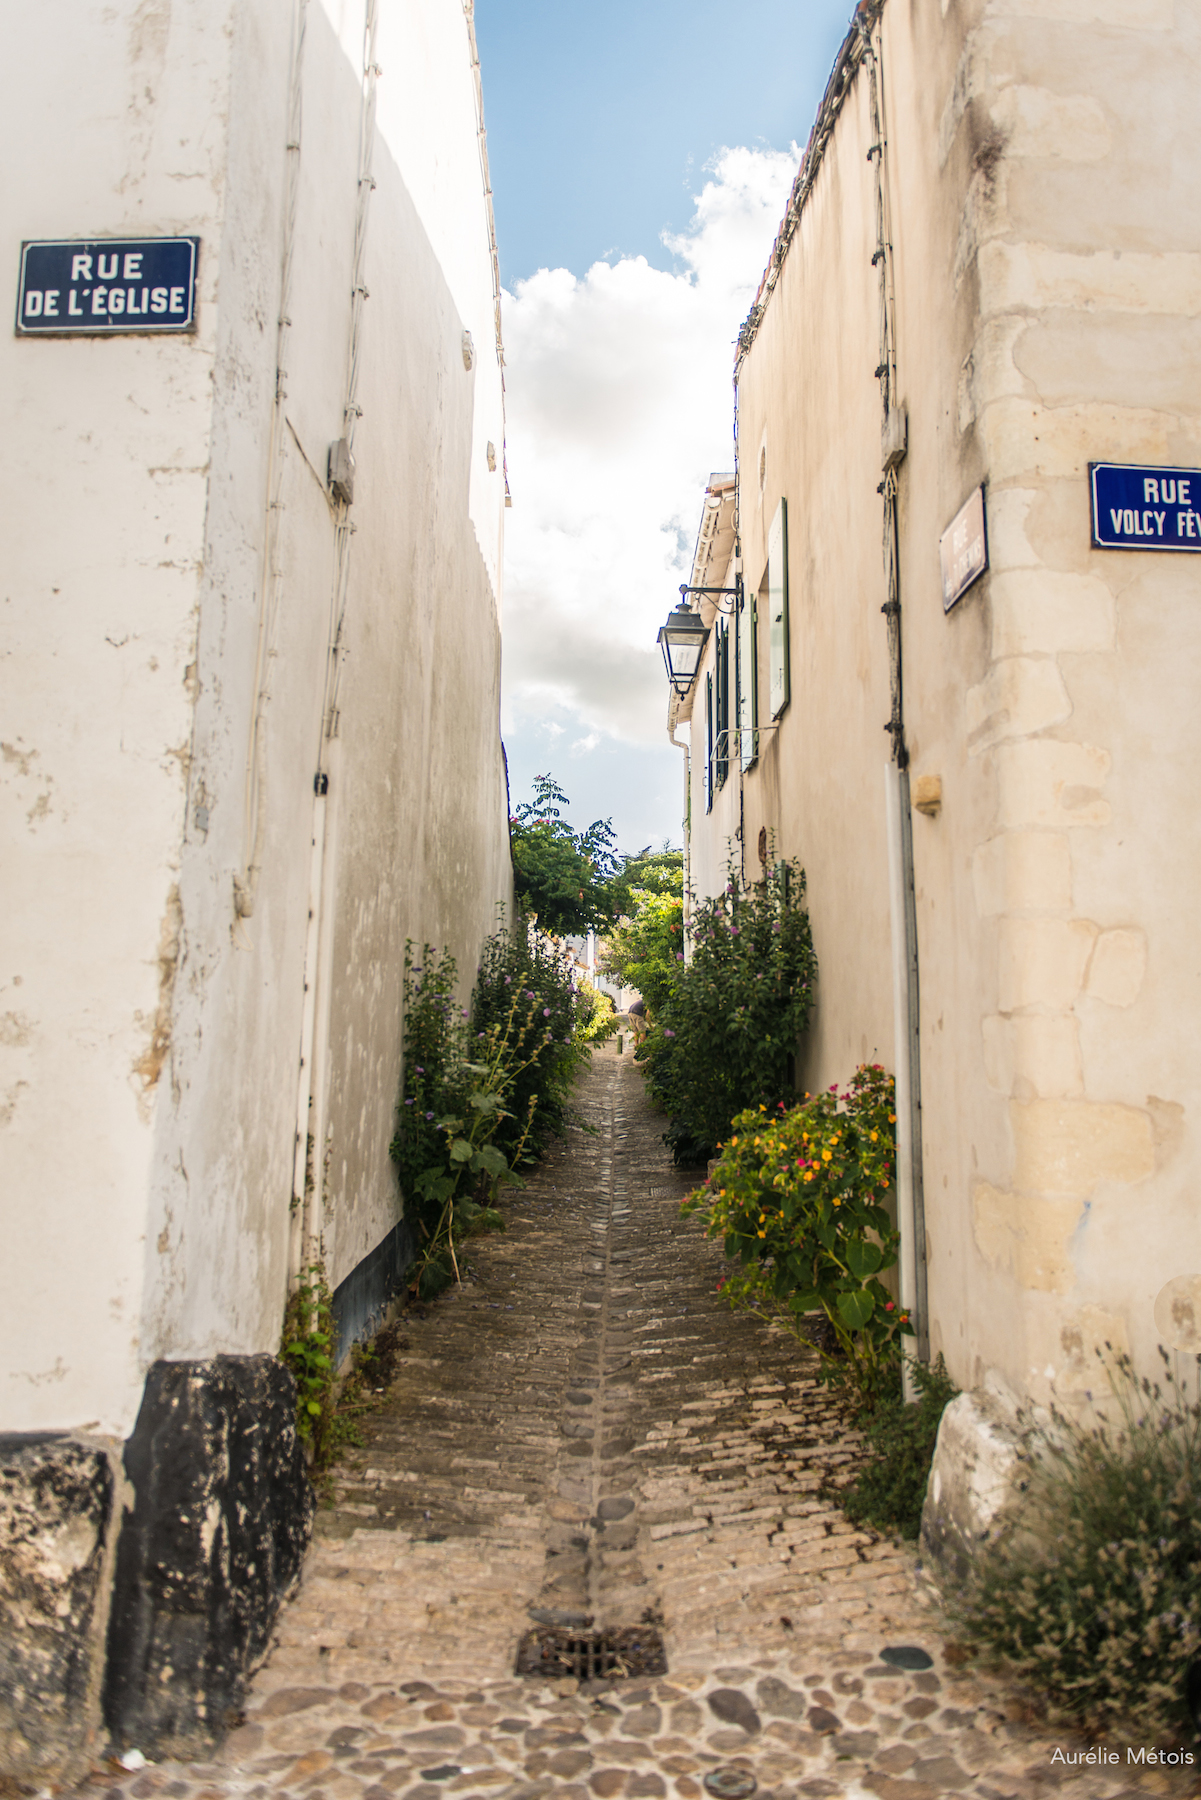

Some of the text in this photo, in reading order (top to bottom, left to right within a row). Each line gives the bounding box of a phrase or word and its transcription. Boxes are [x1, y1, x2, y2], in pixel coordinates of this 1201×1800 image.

[71, 253, 144, 281] RUE
[25, 285, 186, 317] DE L'ÉGLISE
[1143, 477, 1192, 505] RUE
[1110, 508, 1166, 536] VOLCY
